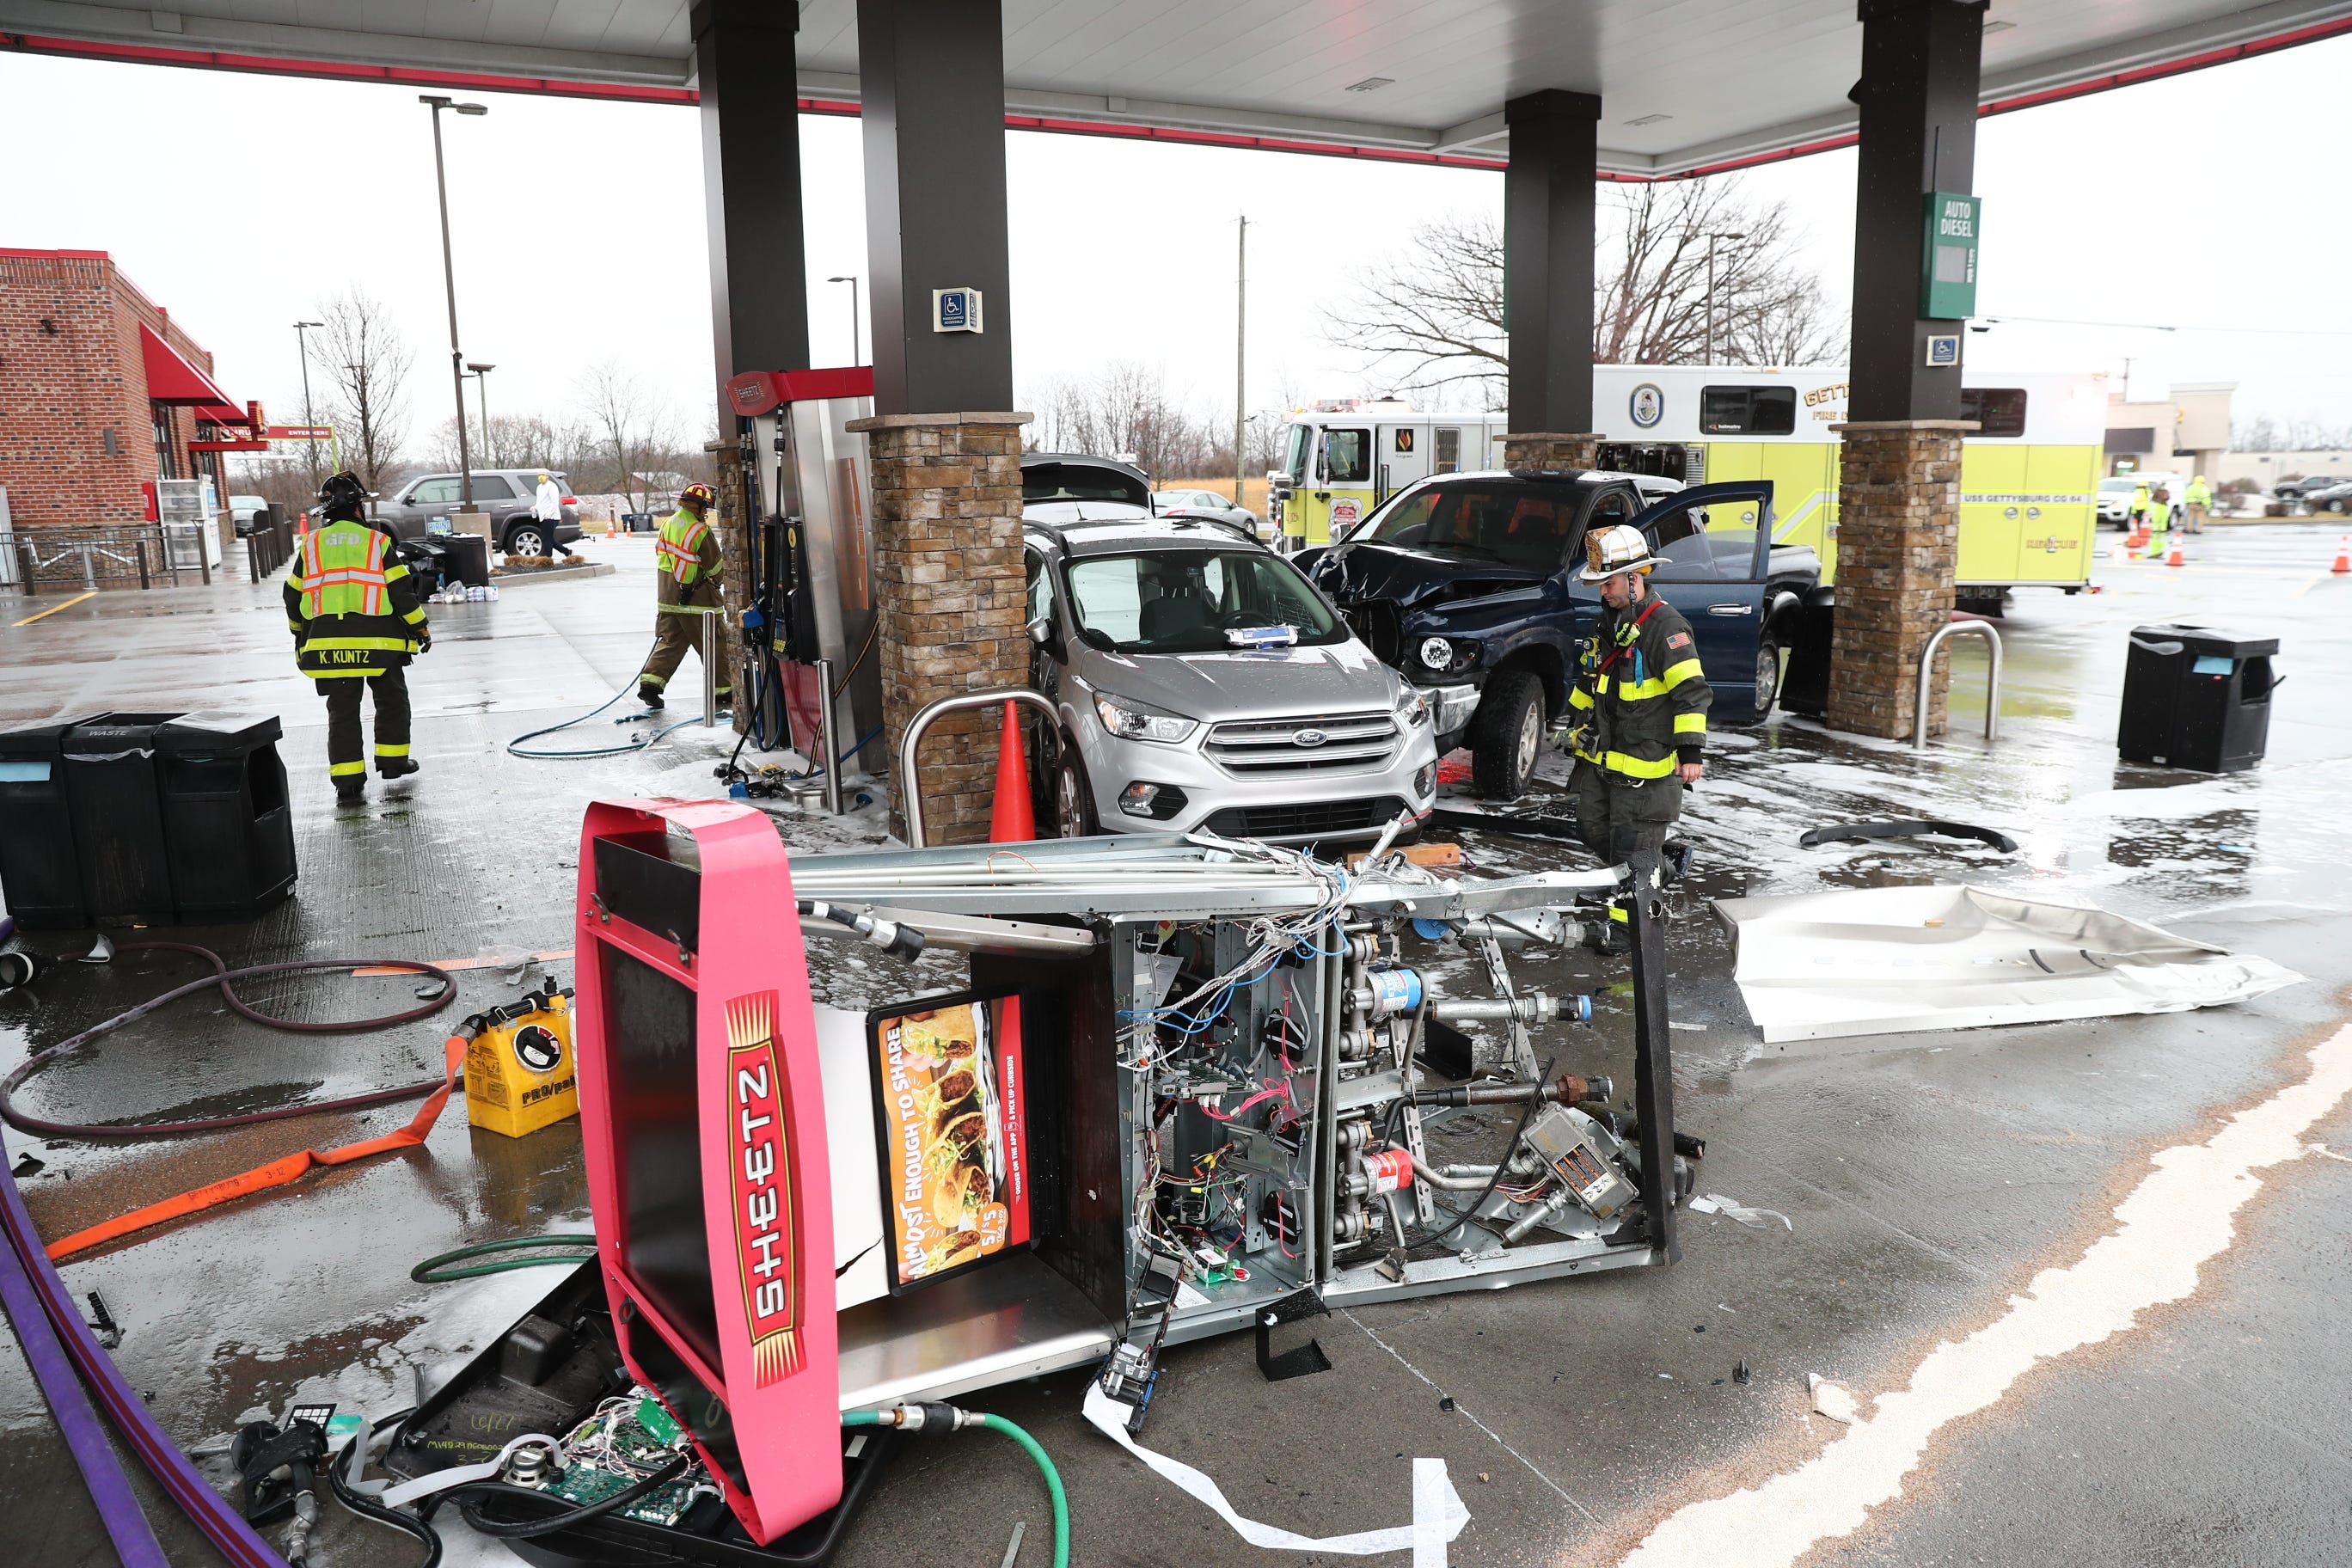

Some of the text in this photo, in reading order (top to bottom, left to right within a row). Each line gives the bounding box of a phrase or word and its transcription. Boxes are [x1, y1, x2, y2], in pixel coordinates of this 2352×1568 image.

[1945, 200, 1971, 219] AUTO
[1940, 218, 1973, 237] DIESEL
[1812, 411, 1837, 420] FIRE
[325, 532, 361, 546] GFD
[319, 650, 370, 664] K. KUNTZ
[1301, 732, 1320, 742] Ford
[1006, 1055, 1014, 1088] CURBSIDE
[1008, 1088, 1015, 1099] UP
[887, 1026, 927, 1277] ALMOST ENOUGH TO SHARE
[265, 1167, 286, 1179] 3-12
[1013, 1161, 1020, 1172] ON
[737, 1063, 786, 1320] SHEETZ
